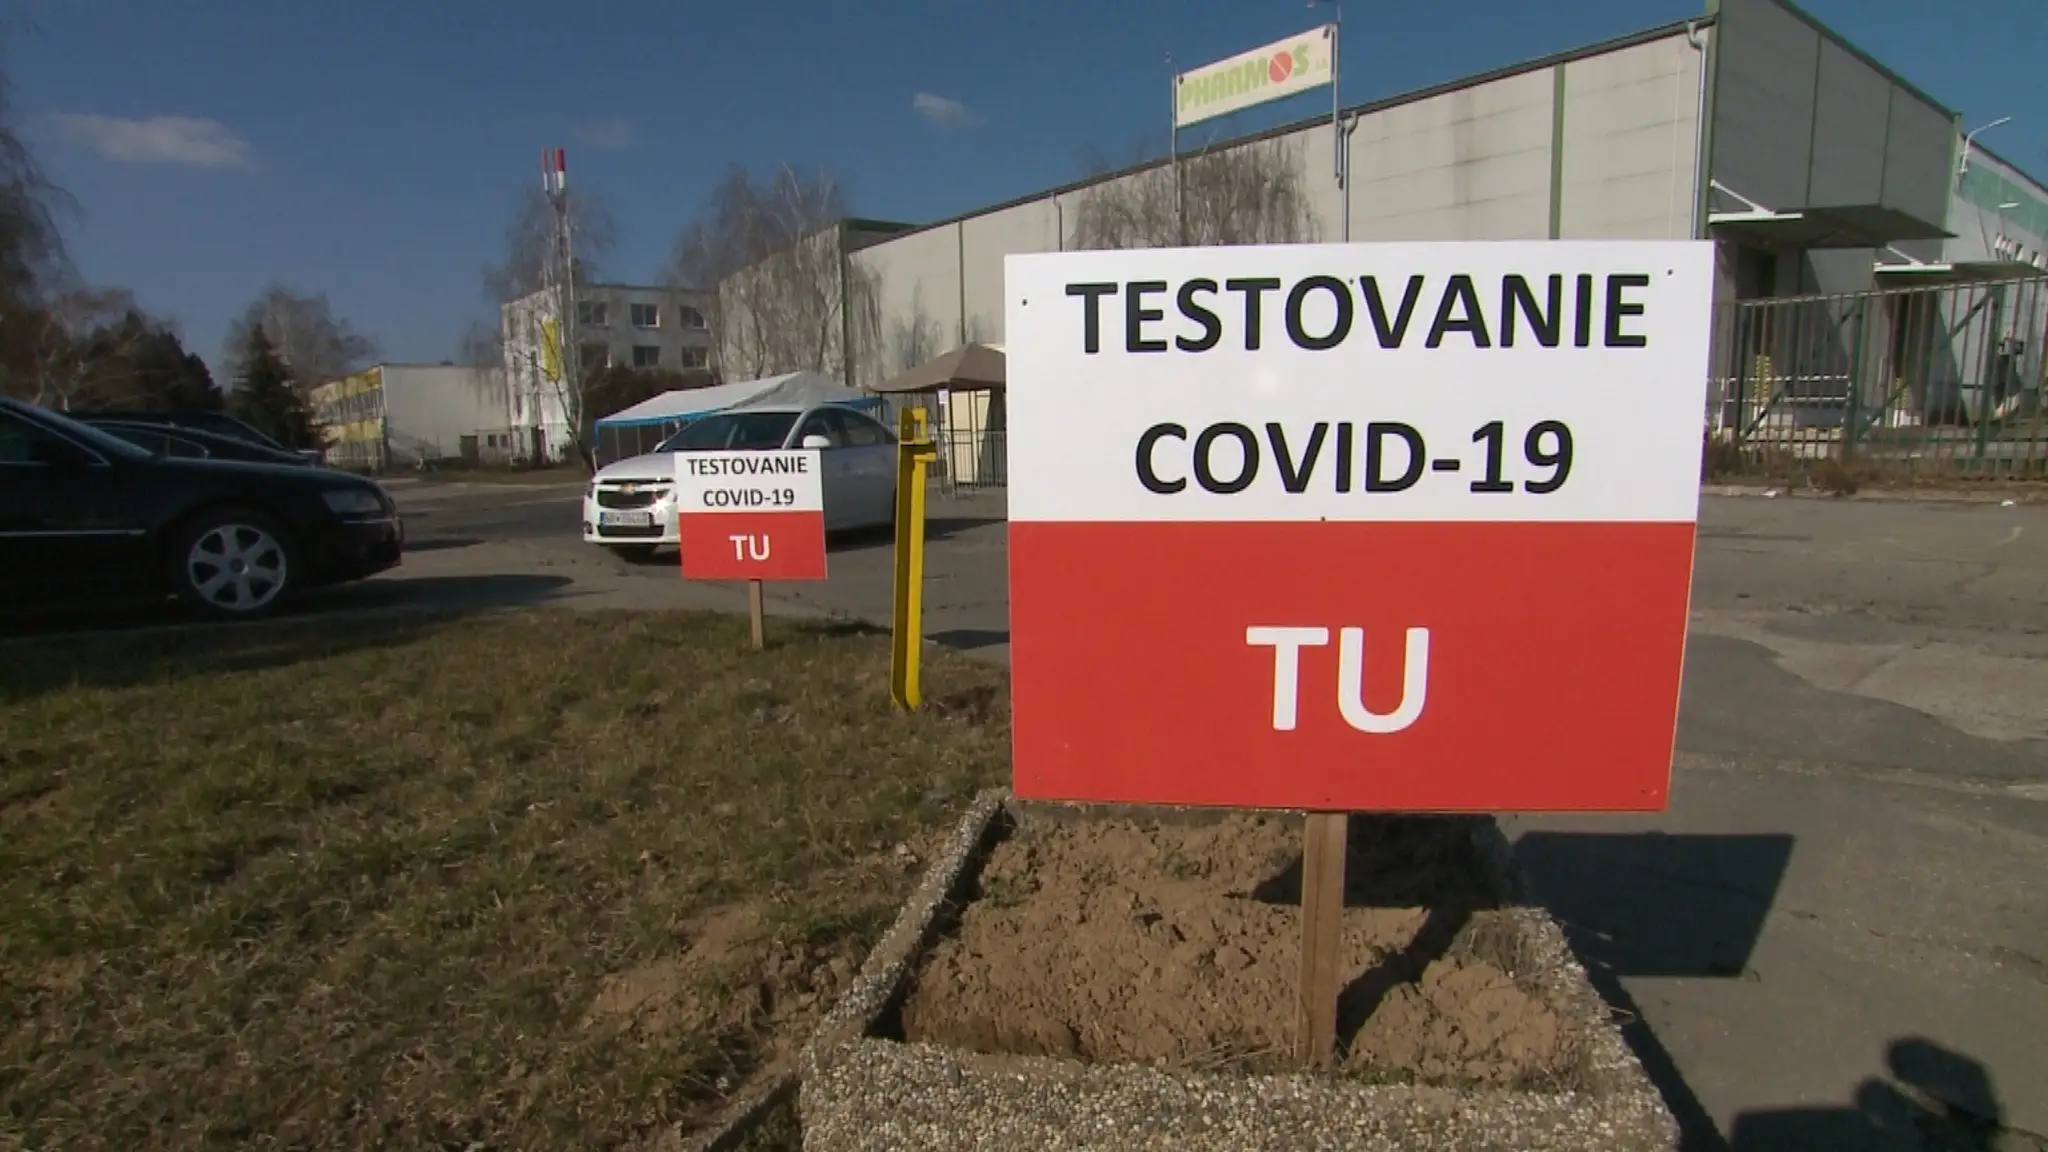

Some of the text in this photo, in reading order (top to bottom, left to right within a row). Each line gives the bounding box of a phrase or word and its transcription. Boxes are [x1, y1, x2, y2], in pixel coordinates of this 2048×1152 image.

[1179, 44, 1310, 113] PHARMOS
[1065, 273, 1650, 354] TESTOVANIE
[687, 456, 808, 476] TESTOVANIE
[1135, 419, 1574, 495] COVID-19
[703, 488, 795, 507] COVID-19
[729, 533, 771, 561] TU
[1246, 626, 1430, 734] TU
